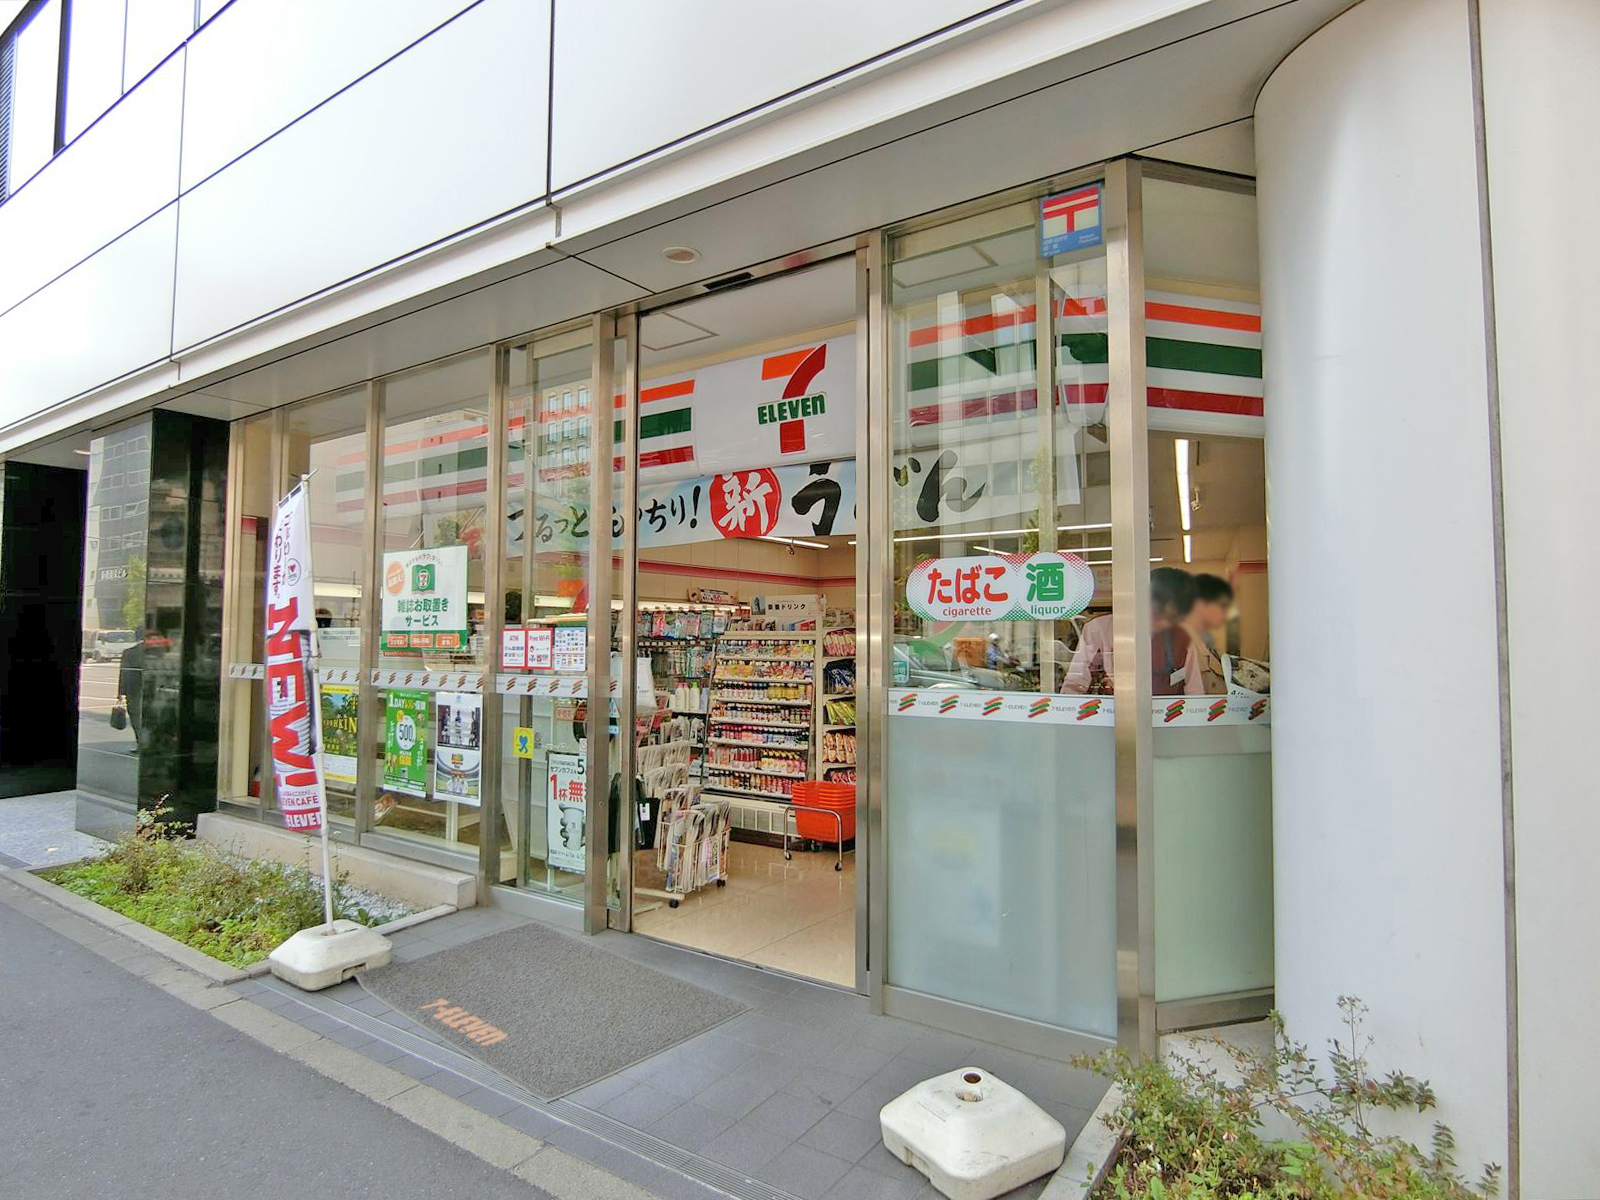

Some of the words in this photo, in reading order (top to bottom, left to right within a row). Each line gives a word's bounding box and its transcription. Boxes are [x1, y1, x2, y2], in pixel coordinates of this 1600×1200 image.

[719, 470, 772, 537] 新
[791, 463, 986, 536] うん
[927, 564, 1009, 604] たばこ
[1026, 562, 1065, 602] 酒
[405, 614, 439, 627] サービス
[942, 606, 992, 617] cigarette
[1030, 604, 1066, 615] liquor
[399, 724, 414, 741] 500
[550, 774, 587, 803] 1杯無
